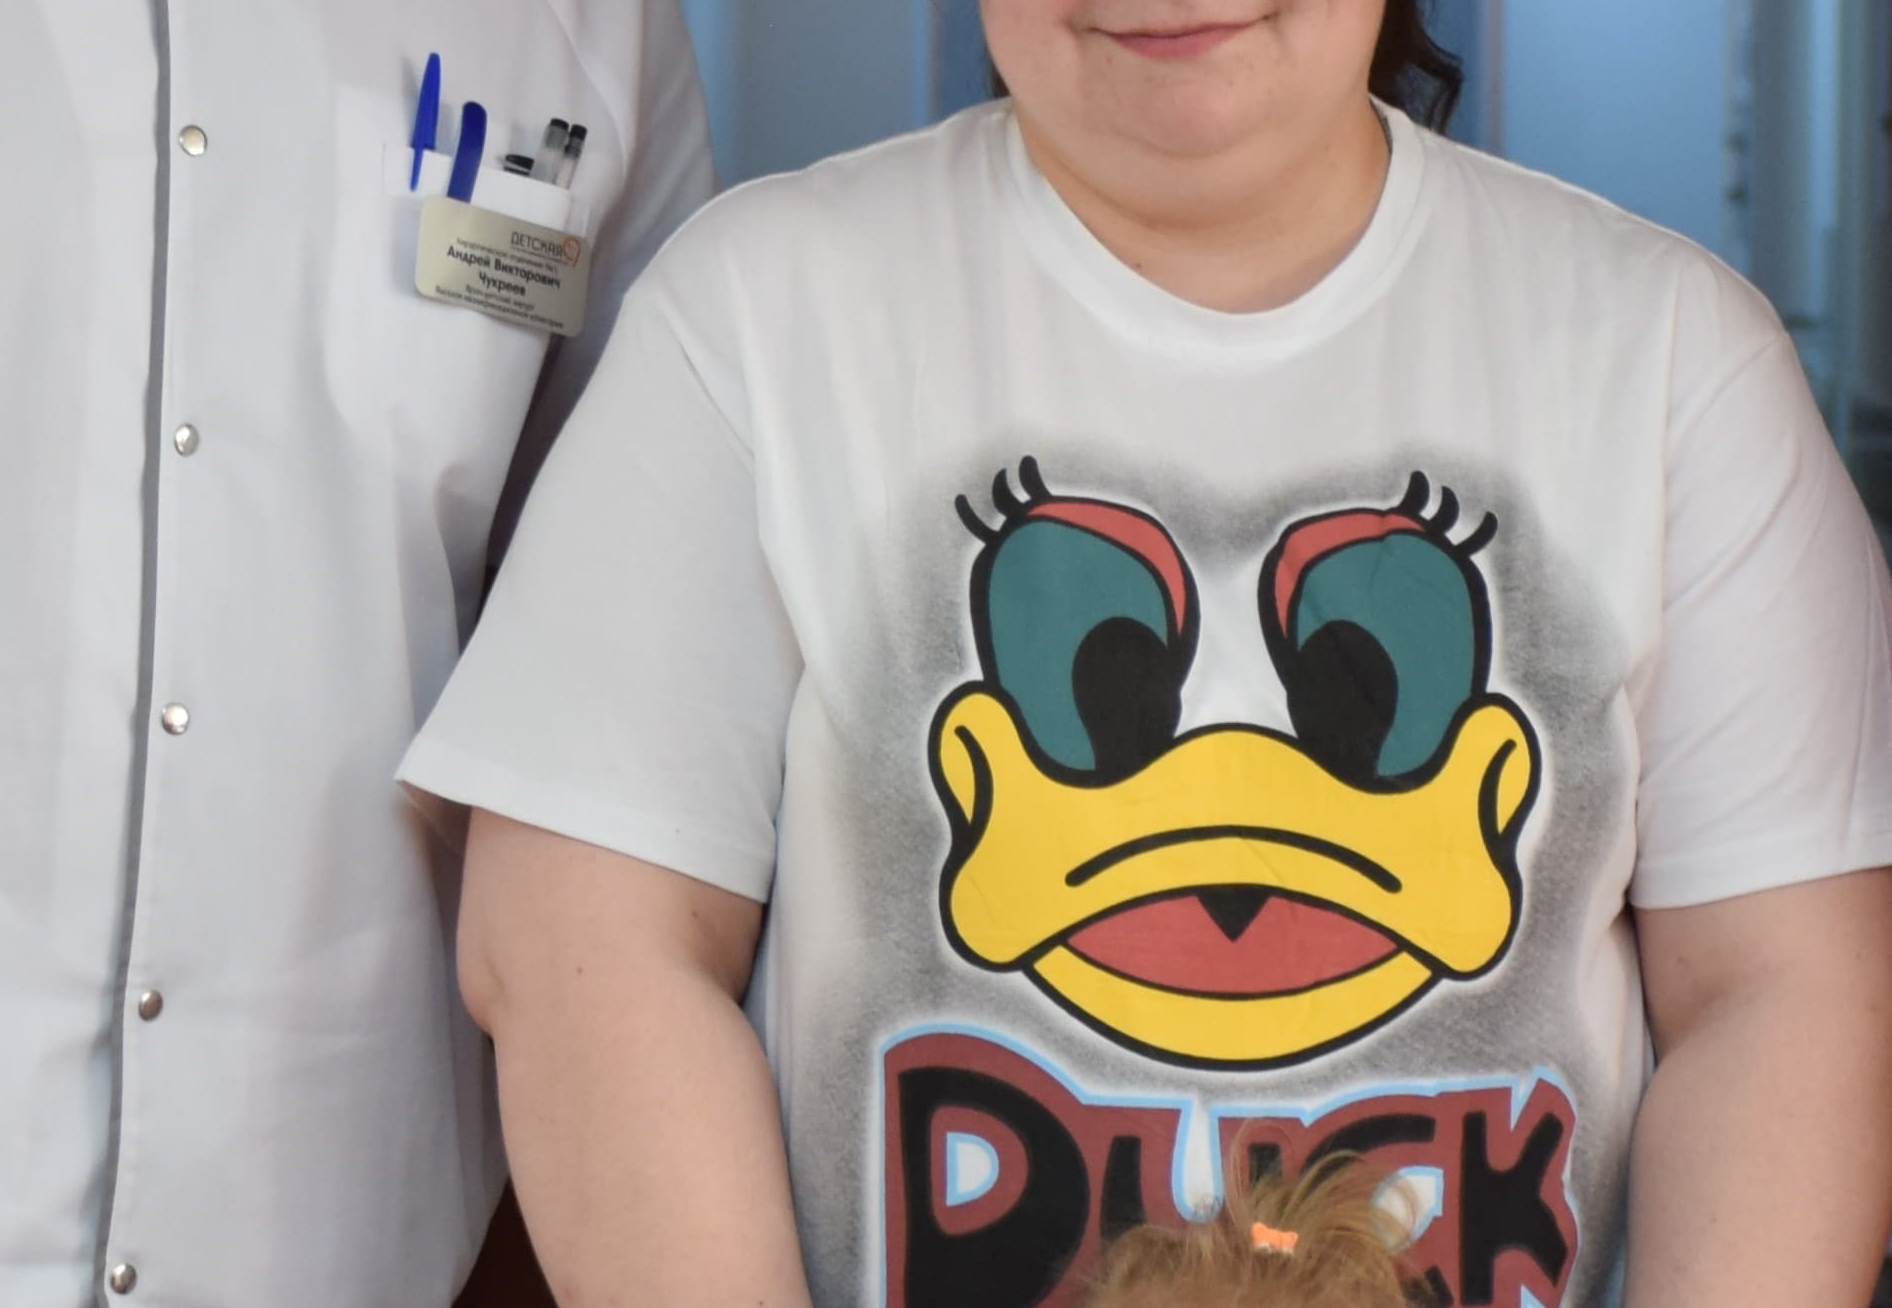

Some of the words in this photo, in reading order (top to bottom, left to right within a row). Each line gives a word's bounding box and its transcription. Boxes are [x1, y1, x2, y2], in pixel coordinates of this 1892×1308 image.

[511, 231, 563, 258] ДЕТСКАЯ
[447, 245, 490, 268] Андрей
[494, 259, 561, 289] Викторович
